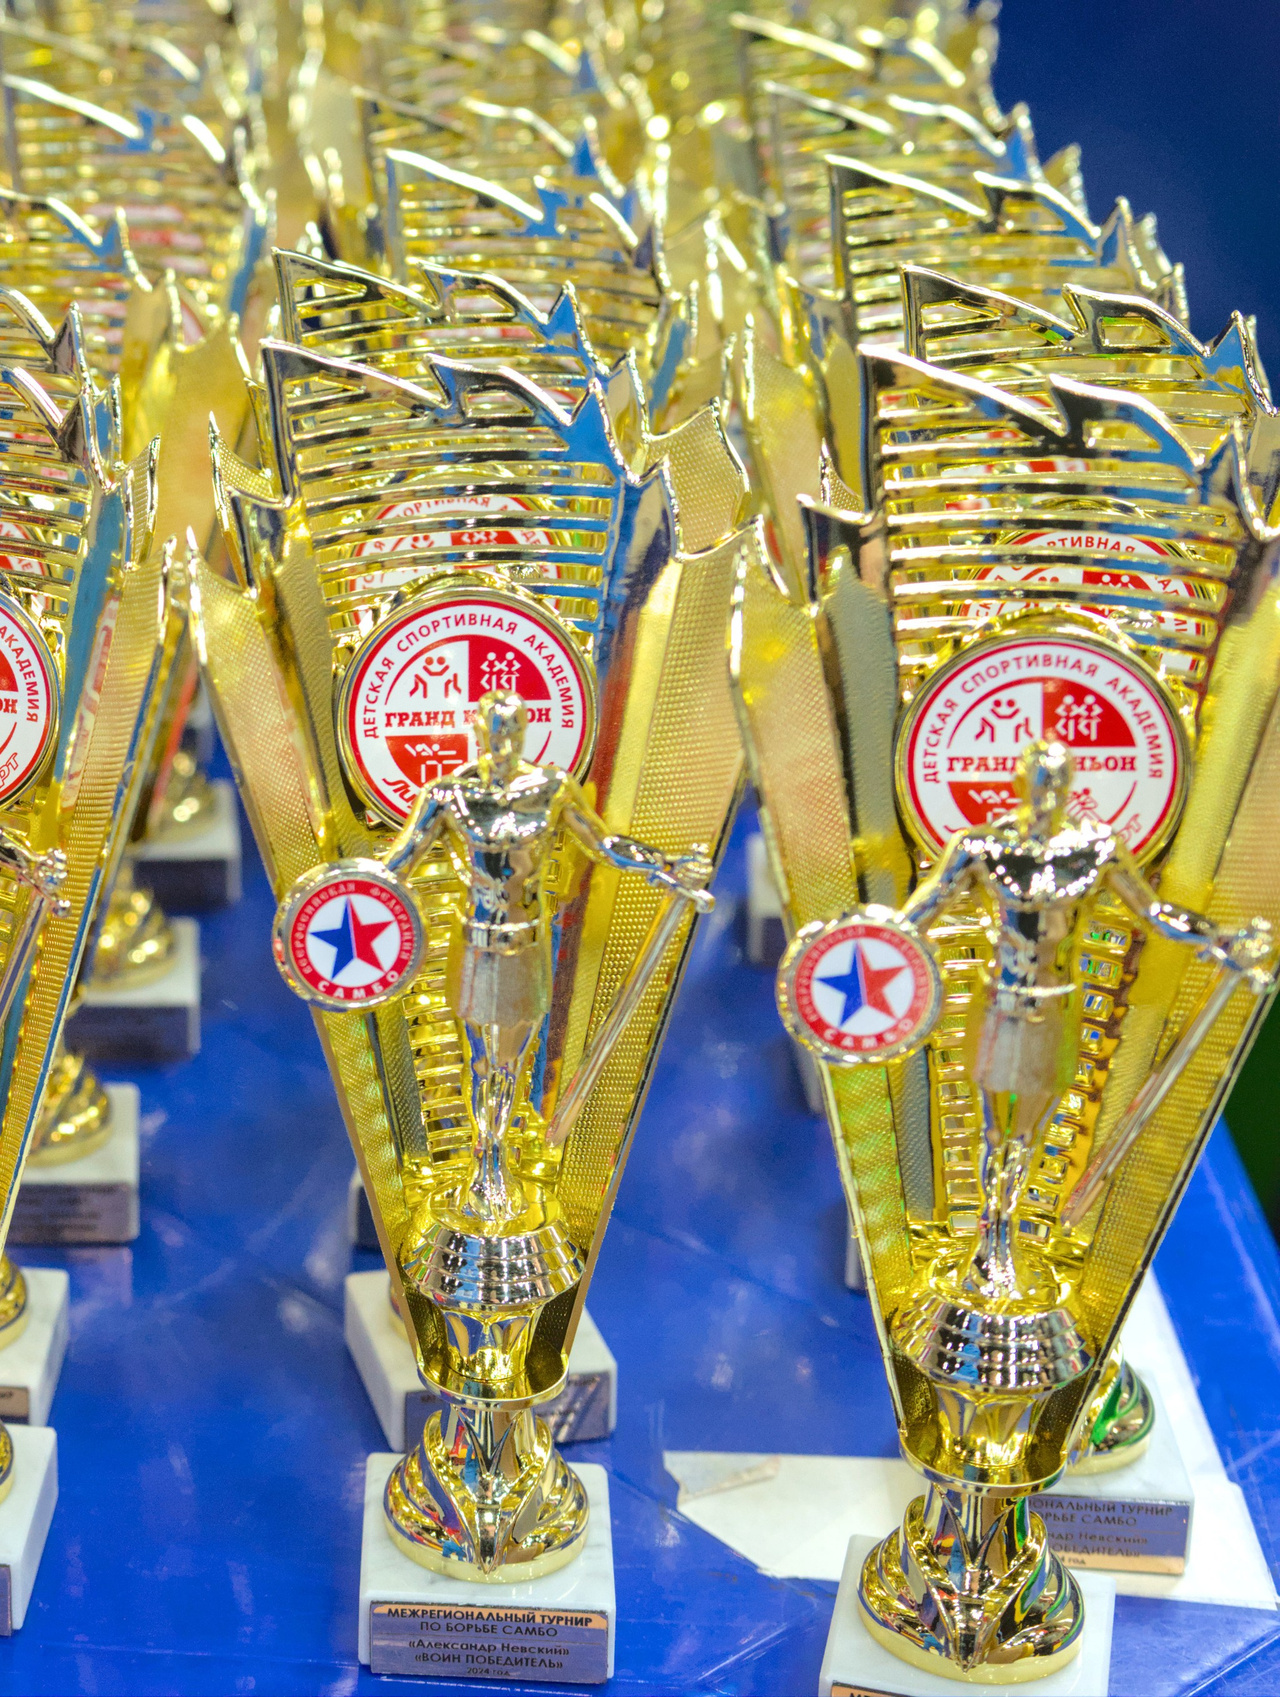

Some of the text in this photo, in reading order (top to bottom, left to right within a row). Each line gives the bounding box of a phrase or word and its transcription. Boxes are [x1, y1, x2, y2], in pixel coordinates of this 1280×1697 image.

[363, 613, 574, 739] ДЕТСКАЯ СПОРТИВНАЯ АКАДЕМИЯ
[384, 711, 456, 729] ГРАНД
[923, 654, 1165, 783] ДЕТСКАЯ СПОРТИВНАЯ АКАДЕМИЯ
[947, 755, 1137, 772] ГРАН НЬОН
[317, 971, 399, 999] САМБО
[1121, 1503, 1173, 1517] ТУРНИР
[1081, 1514, 1137, 1527] САМБО
[387, 1607, 593, 1627] МЕЖРЕГИОНАЛЬНЫЙ ТУРНИР
[420, 1621, 558, 1637] ПО БОРЬБЕ САМБО
[408, 1639, 570, 1656] «Александр Невский»
[414, 1652, 563, 1669] «ВОИН ПОБЕДИТЕЛЬ»
[467, 1666, 490, 1675] 2024
